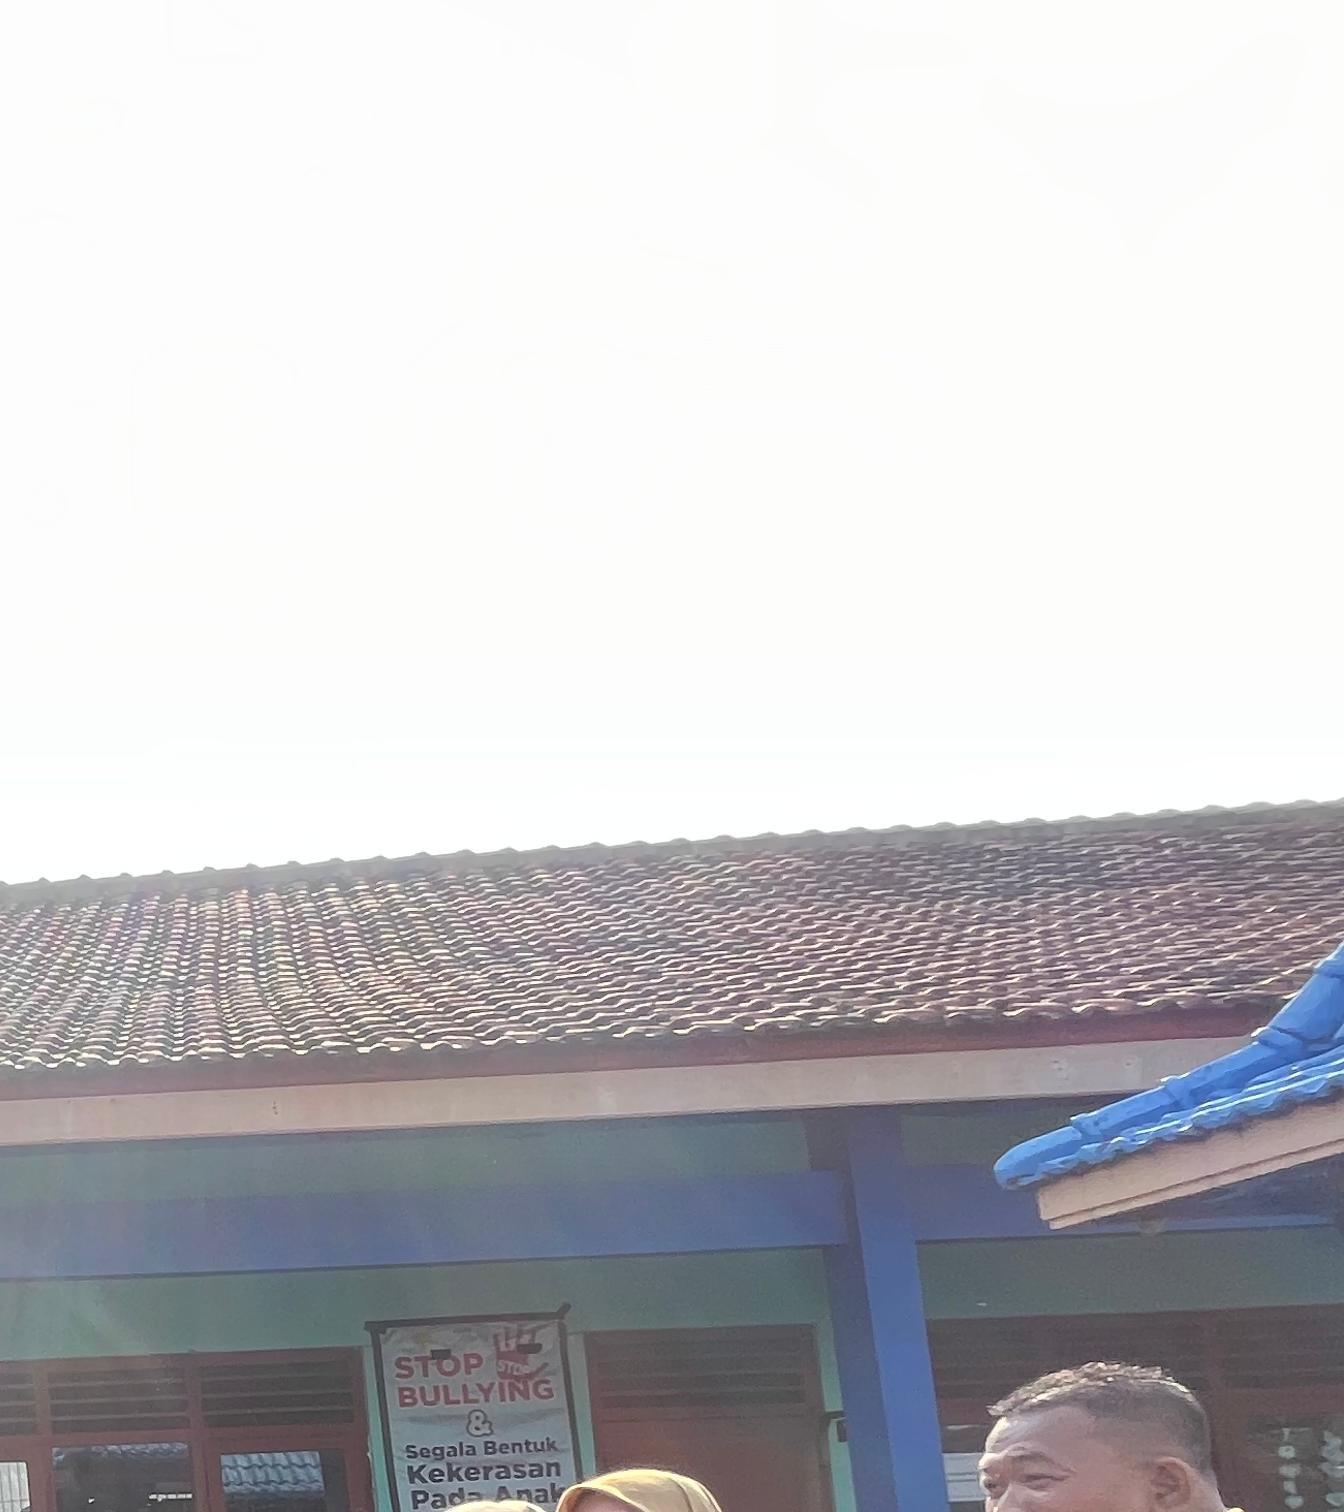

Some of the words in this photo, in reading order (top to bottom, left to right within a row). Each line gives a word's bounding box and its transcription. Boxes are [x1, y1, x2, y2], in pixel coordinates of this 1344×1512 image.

[394, 1352, 484, 1379] STOP
[397, 1379, 555, 1408] BULLYING
[465, 1408, 494, 1437] &
[405, 1441, 477, 1461] Segala
[484, 1436, 558, 1456] Bentuk
[406, 1461, 561, 1485] Kekerasan
